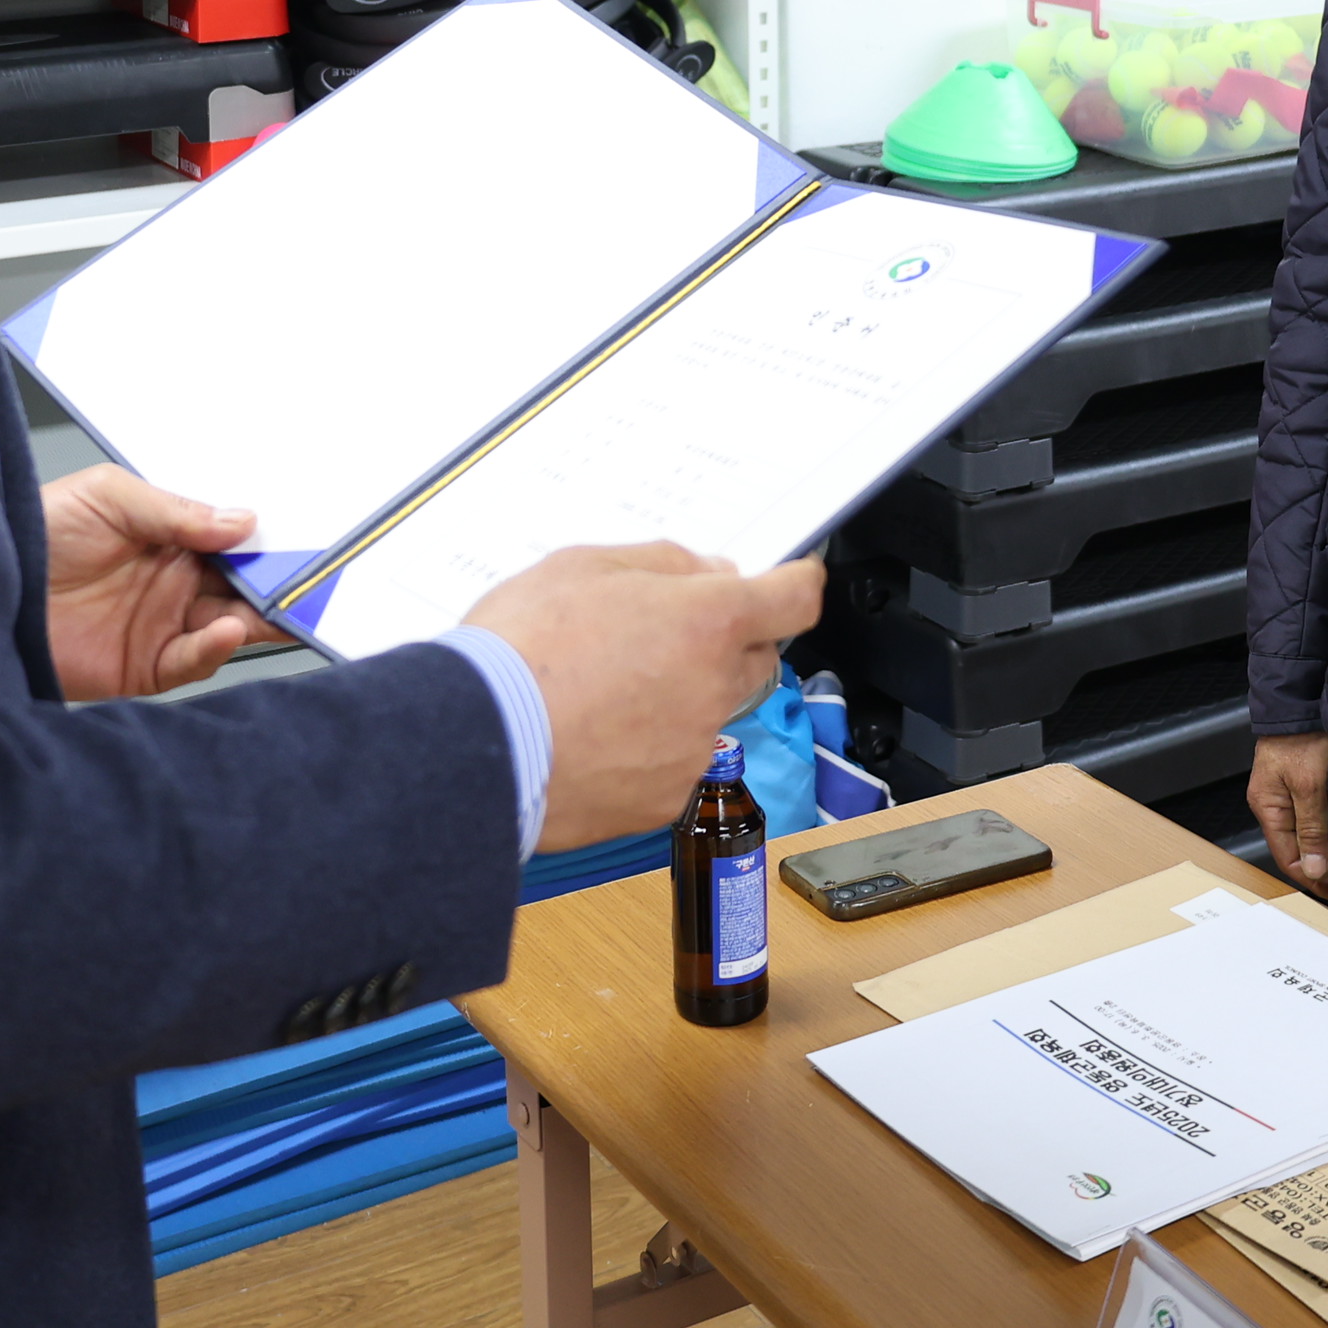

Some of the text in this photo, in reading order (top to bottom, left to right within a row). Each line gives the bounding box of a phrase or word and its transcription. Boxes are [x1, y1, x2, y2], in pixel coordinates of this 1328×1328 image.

[331, 68, 364, 78] RCLE
[1023, 1027, 1211, 1138] 2025년도 영동군체육회
[1078, 1039, 1204, 1108] 정기대의원총회
[1232, 1193, 1306, 1239] 영동군
